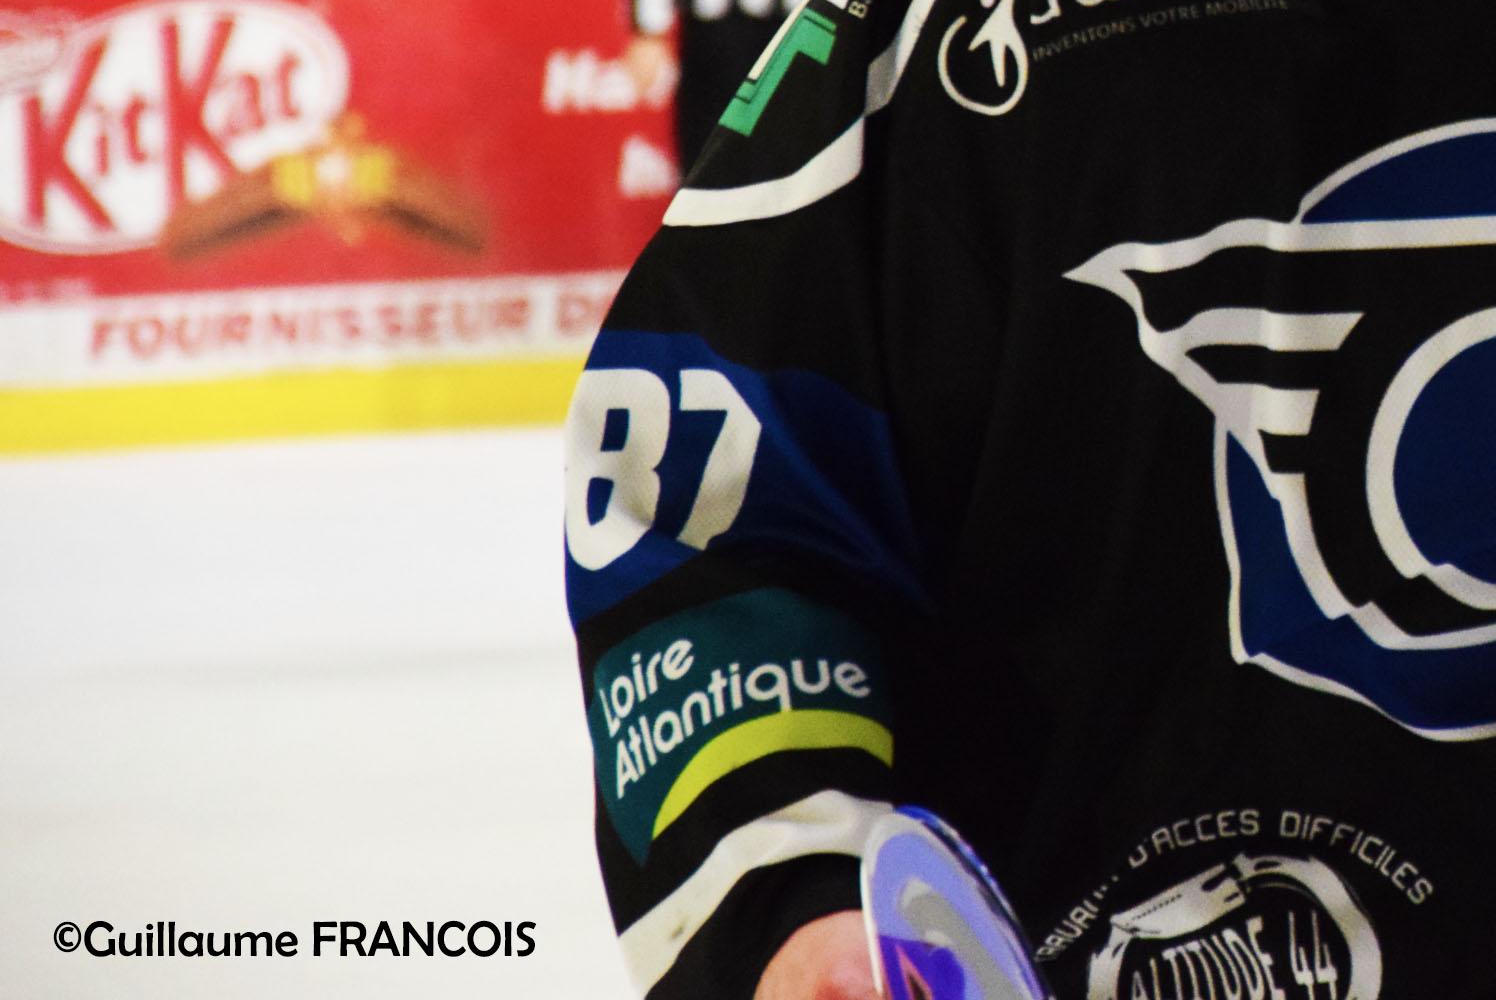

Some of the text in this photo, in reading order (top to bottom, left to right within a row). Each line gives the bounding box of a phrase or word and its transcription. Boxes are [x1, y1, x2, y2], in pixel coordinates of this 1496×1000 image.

[1139, 3, 1201, 30] VOTRE
[564, 368, 762, 571] 87
[600, 637, 696, 739] Loire
[612, 659, 872, 799] Atlantique
[1279, 809, 1434, 905] DIFFICILES
[1288, 909, 1339, 1000] 44
